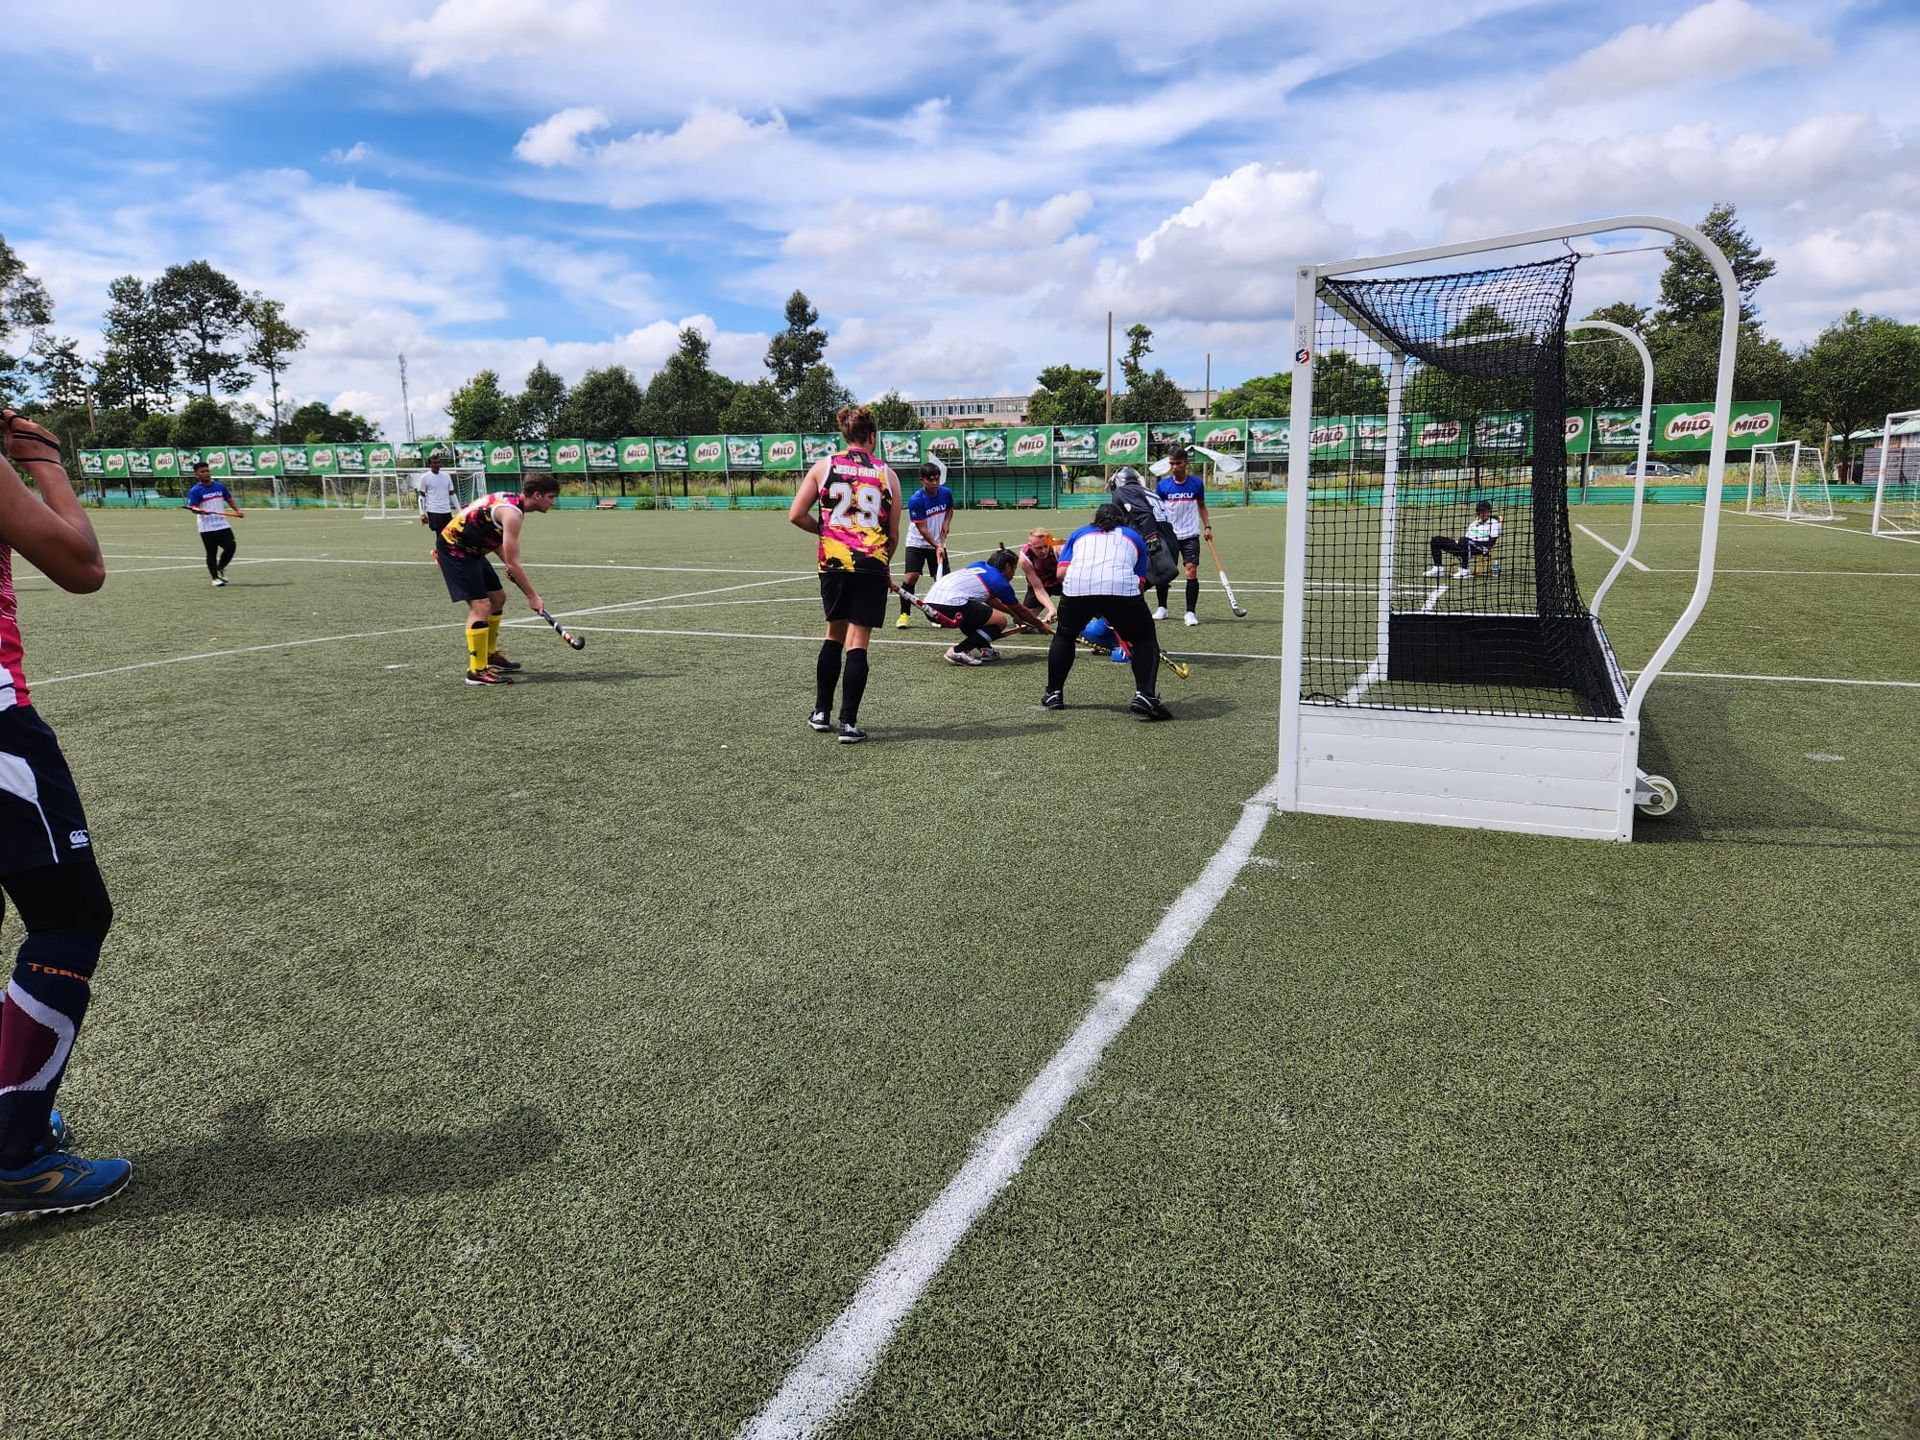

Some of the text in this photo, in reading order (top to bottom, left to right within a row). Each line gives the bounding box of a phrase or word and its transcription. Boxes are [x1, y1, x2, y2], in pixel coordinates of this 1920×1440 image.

[1671, 419, 1711, 434] MILO
[1734, 419, 1769, 432] MILO
[1017, 440, 1044, 452] MILO
[1110, 437, 1138, 449] MILO
[559, 450, 578, 460] MILO
[626, 449, 647, 459] MILO
[698, 447, 719, 458] MILO
[772, 446, 794, 457] MILO
[833, 465, 857, 476] JESUS
[829, 482, 882, 528] 29
